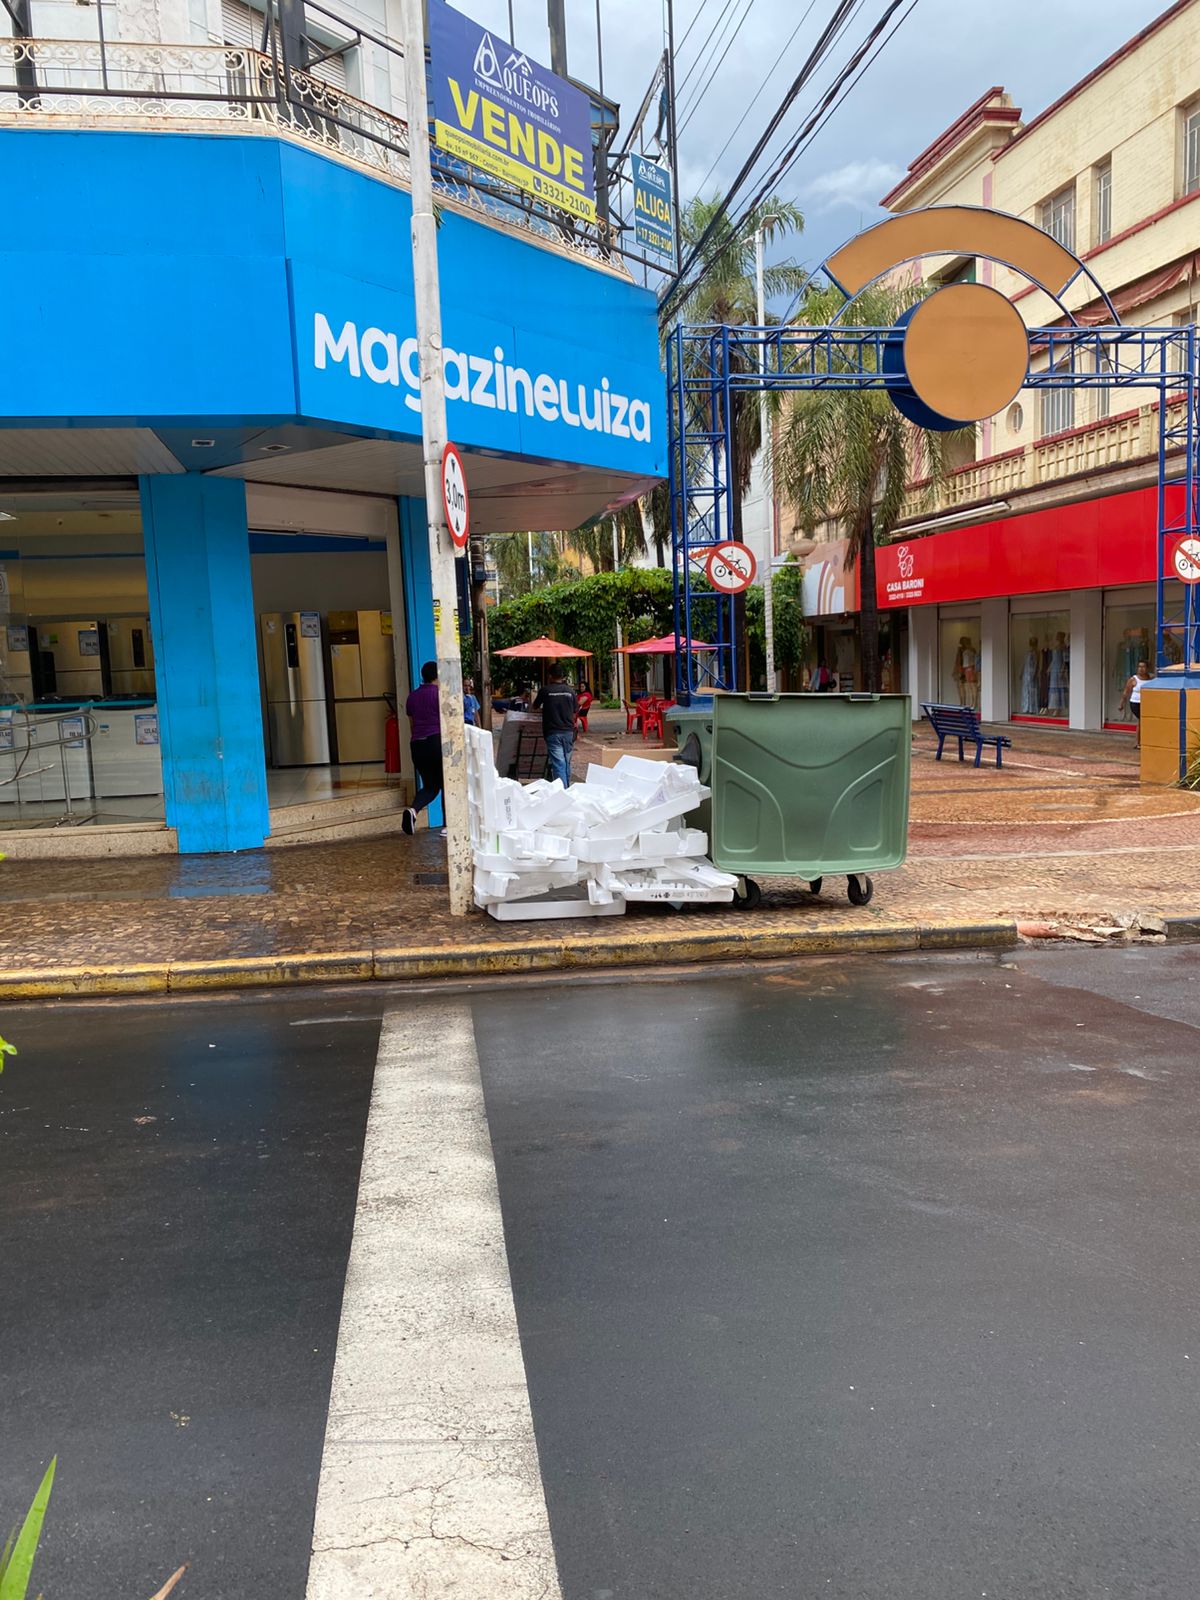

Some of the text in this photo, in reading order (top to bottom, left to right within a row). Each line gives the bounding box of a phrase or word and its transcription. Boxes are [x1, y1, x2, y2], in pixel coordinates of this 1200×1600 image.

[448, 77, 586, 191] VENDE
[542, 182, 591, 216] 3321-2100
[635, 188, 671, 225] ALUGA
[887, 578, 924, 592] CASA BARONI
